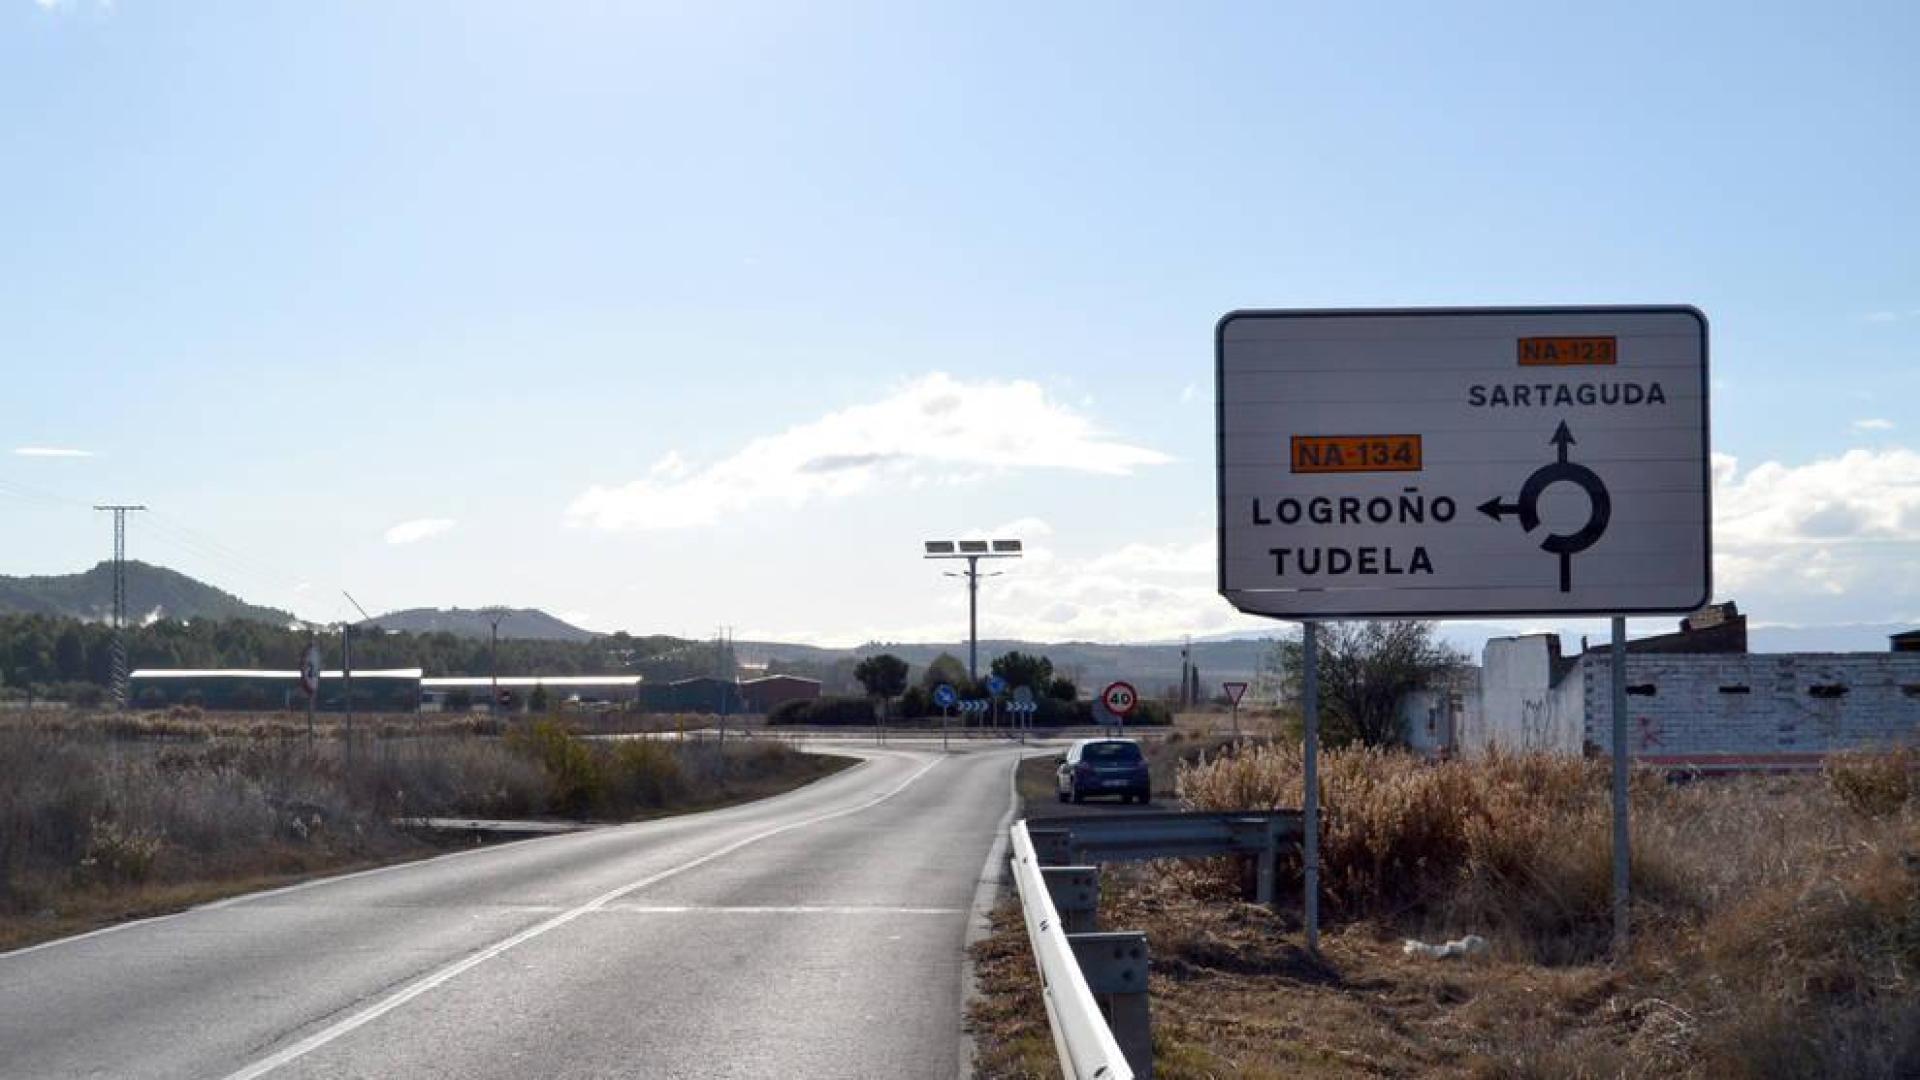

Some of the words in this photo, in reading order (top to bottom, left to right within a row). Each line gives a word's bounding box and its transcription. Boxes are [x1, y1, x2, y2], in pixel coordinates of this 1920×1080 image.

[1468, 382, 1667, 407] SARTAGUDA
[1299, 440, 1413, 466] NA-134
[1252, 486, 1456, 525] LOGROÑO
[1269, 546, 1434, 576] TUDELA
[1109, 692, 1131, 706] 40
